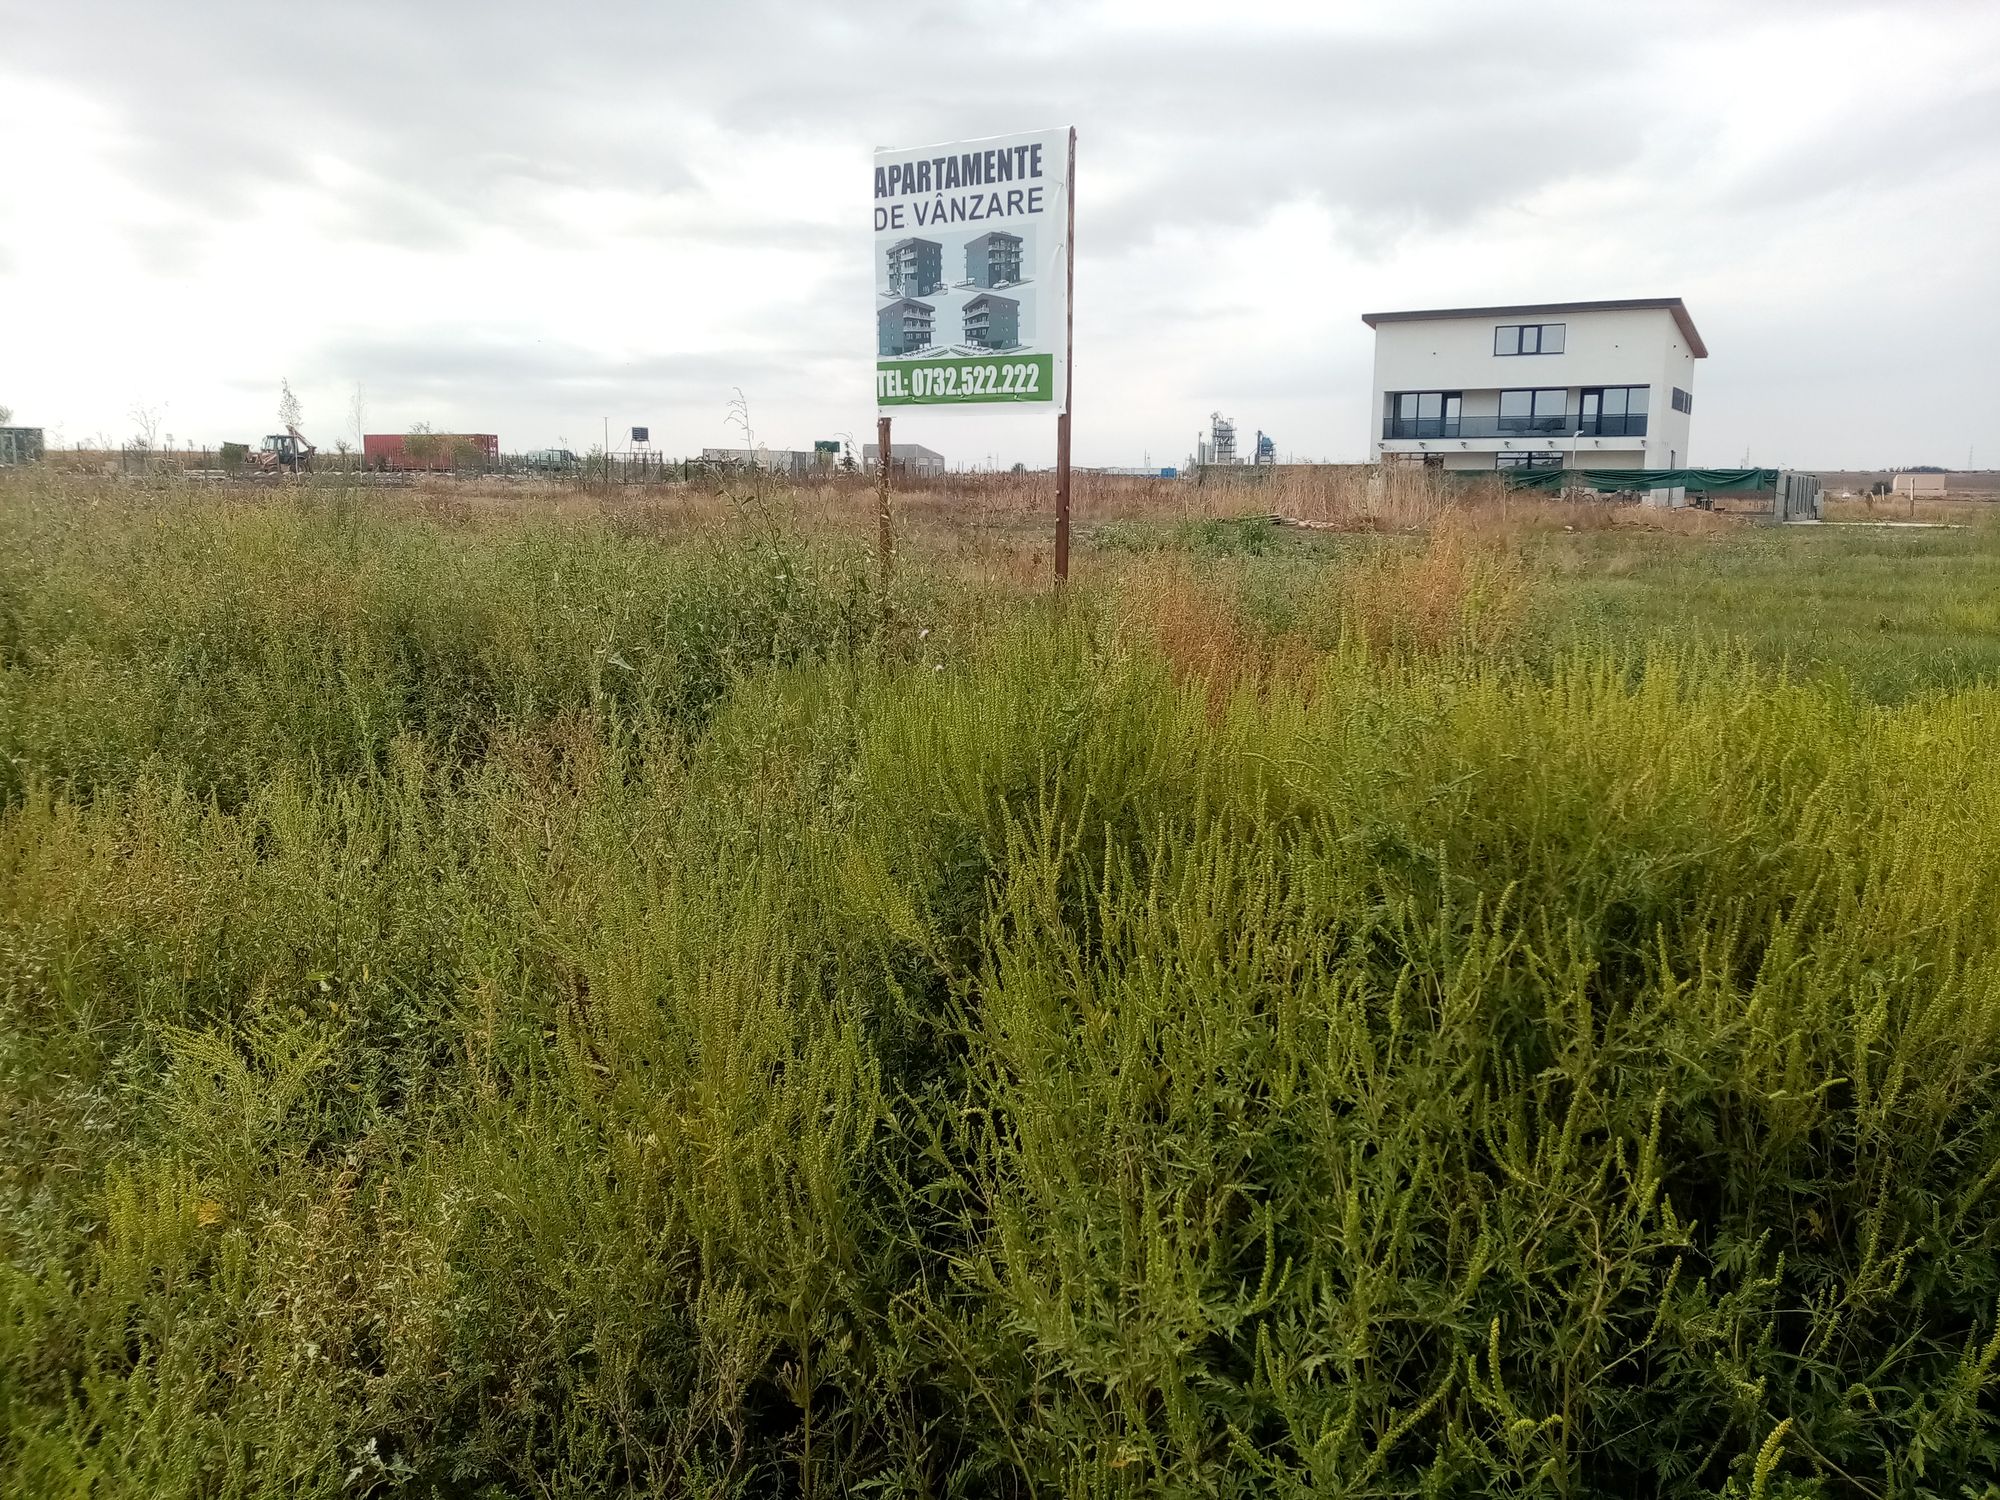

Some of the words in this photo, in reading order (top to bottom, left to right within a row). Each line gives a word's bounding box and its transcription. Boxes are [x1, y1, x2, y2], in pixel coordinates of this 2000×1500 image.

[875, 143, 1042, 198] APARTAMENTE
[875, 204, 905, 232] DE
[914, 187, 1043, 224] VÂNZARE
[877, 369, 908, 397] TEL:
[911, 363, 1039, 397] 0732.522.222
